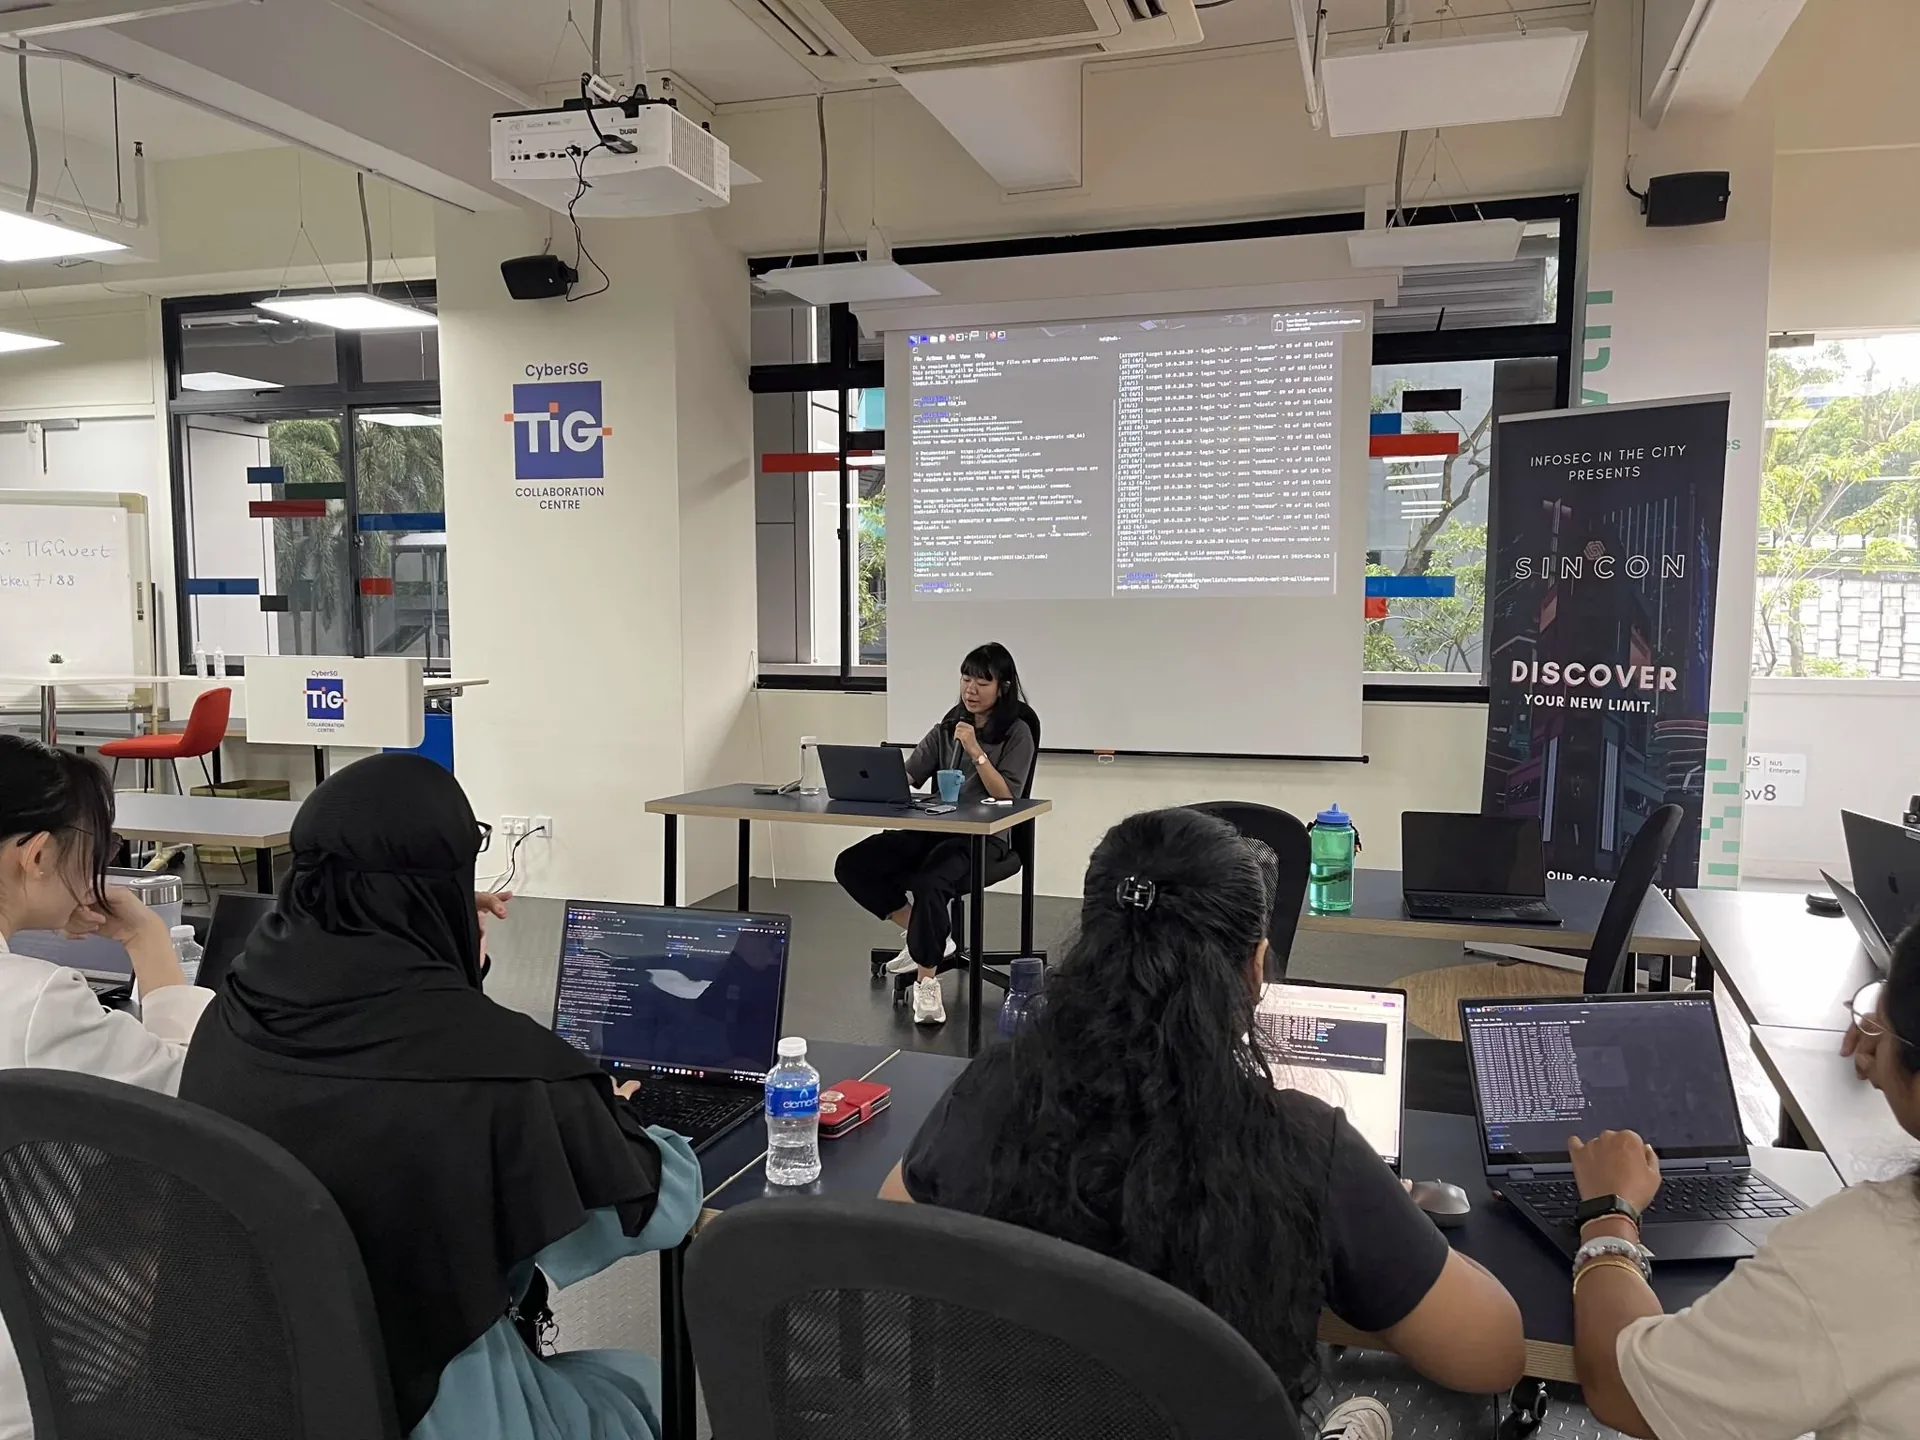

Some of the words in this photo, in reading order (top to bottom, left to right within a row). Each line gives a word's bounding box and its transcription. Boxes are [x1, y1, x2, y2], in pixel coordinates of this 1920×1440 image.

[525, 362, 588, 380] CyberSG
[513, 402, 603, 453] TiG
[1530, 452, 1592, 467] INFOSEC
[1598, 451, 1612, 462] IN
[1619, 448, 1645, 460] THE
[1651, 445, 1687, 458] CITY
[1568, 466, 1641, 481] PRESENTS
[515, 487, 604, 497] COLLABORATION
[539, 500, 580, 509] CENTRE
[1514, 554, 1686, 580] SINCON
[1511, 660, 1678, 691] DISCOVER
[306, 686, 344, 709] TiG
[1524, 693, 1565, 708] YOUR
[1570, 697, 1603, 710] NEW
[1608, 699, 1656, 713] LIMIT.
[1769, 767, 1800, 775] Enterprise
